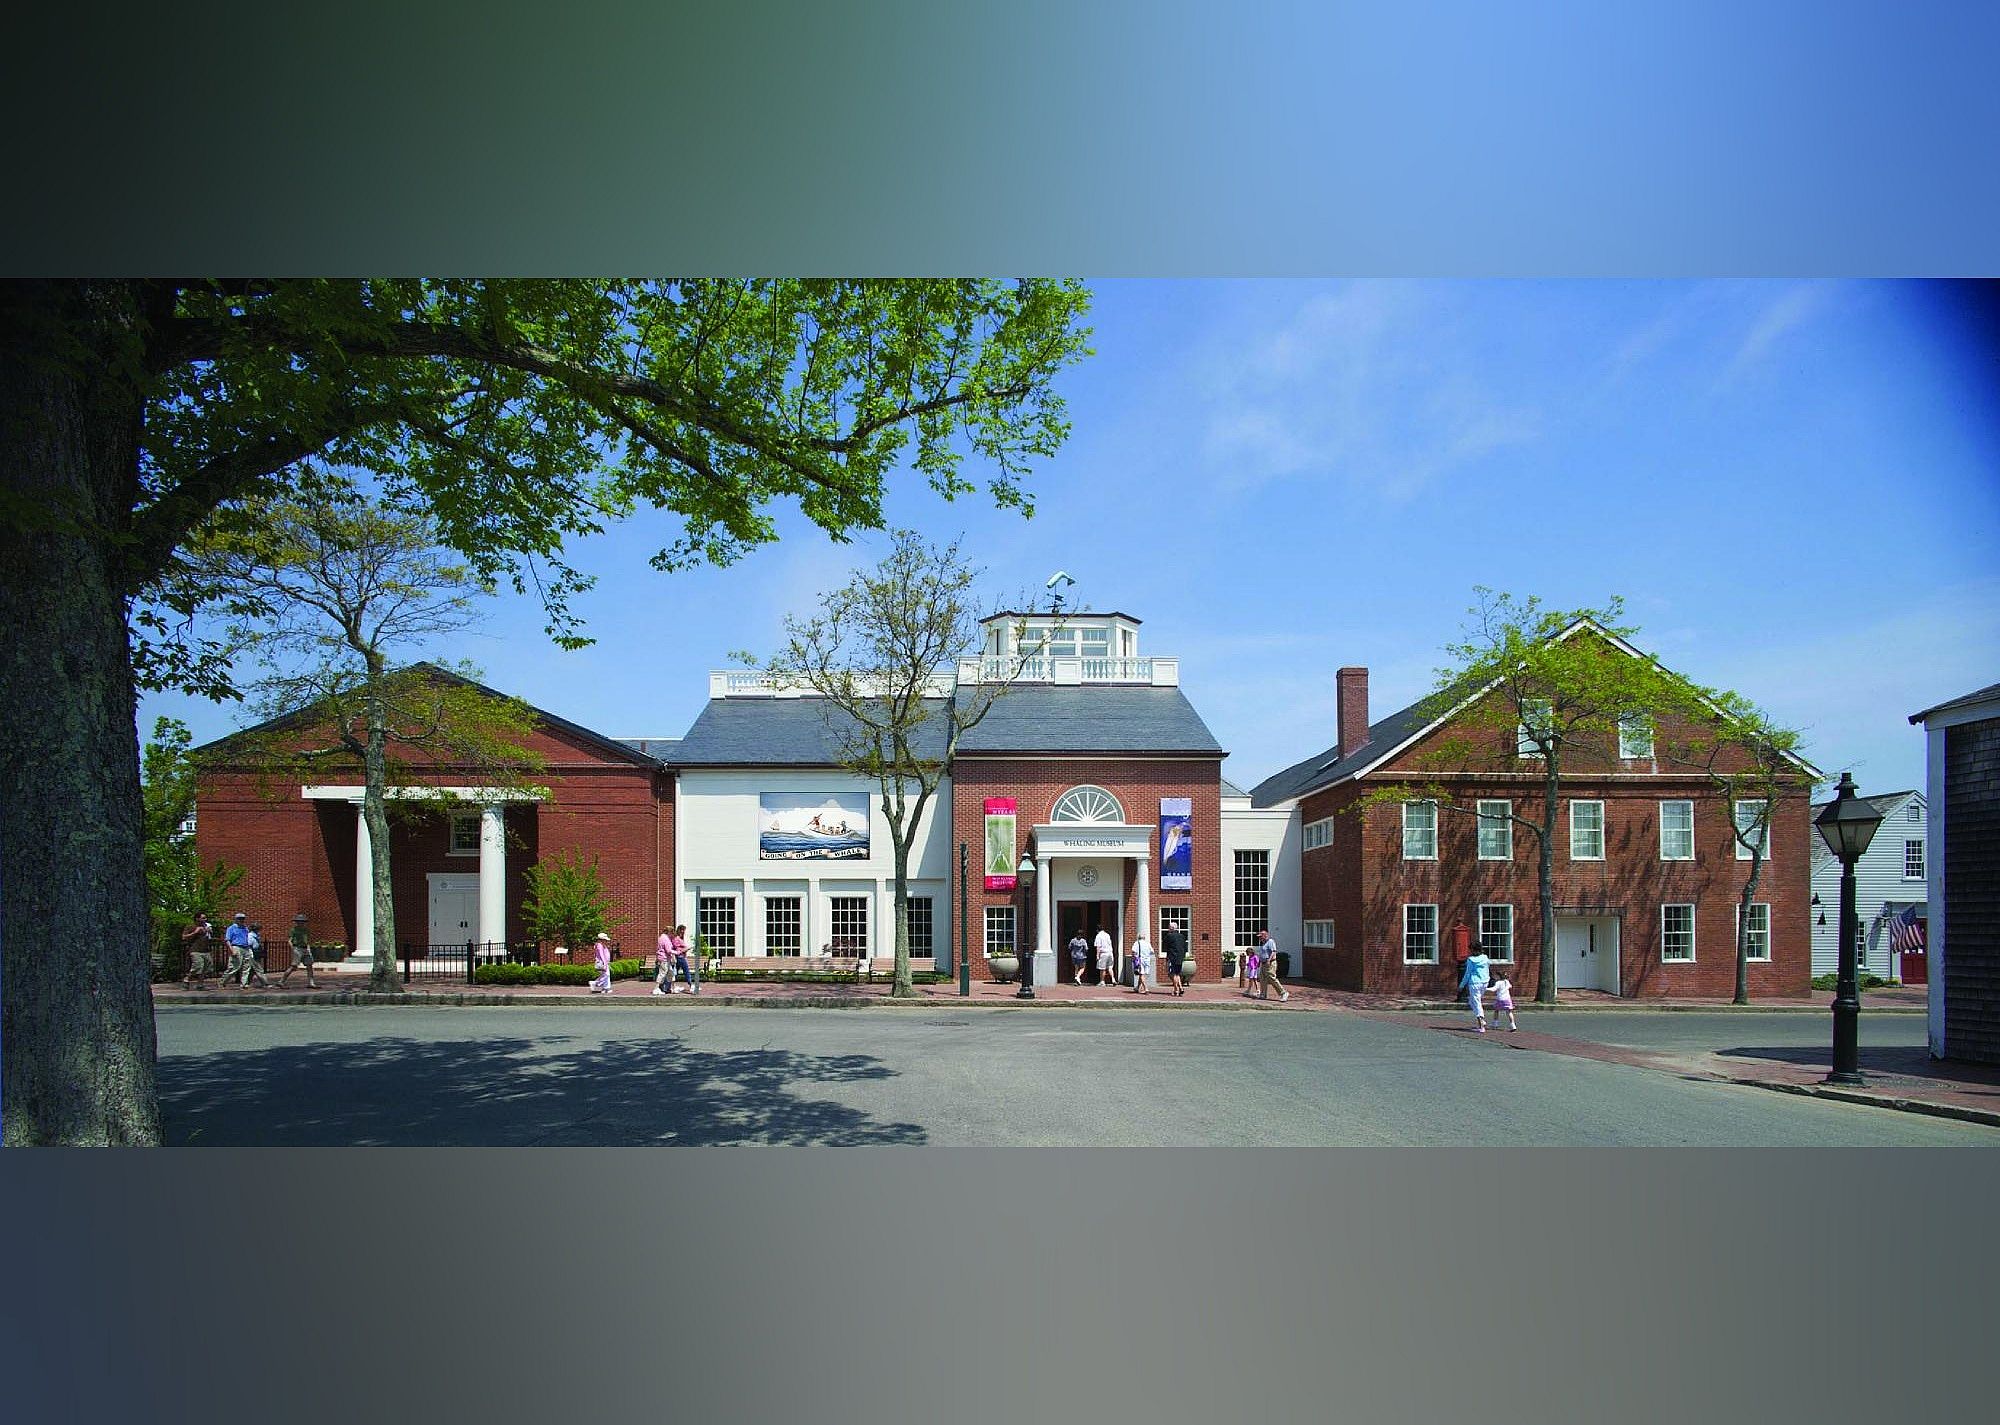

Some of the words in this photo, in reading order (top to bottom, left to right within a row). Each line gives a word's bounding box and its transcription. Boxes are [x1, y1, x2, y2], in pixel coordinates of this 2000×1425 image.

[1063, 839, 1096, 847] WHALING
[1097, 839, 1125, 847] MUSEUM
[810, 849, 823, 857] THE
[834, 848, 861, 857] WHALE
